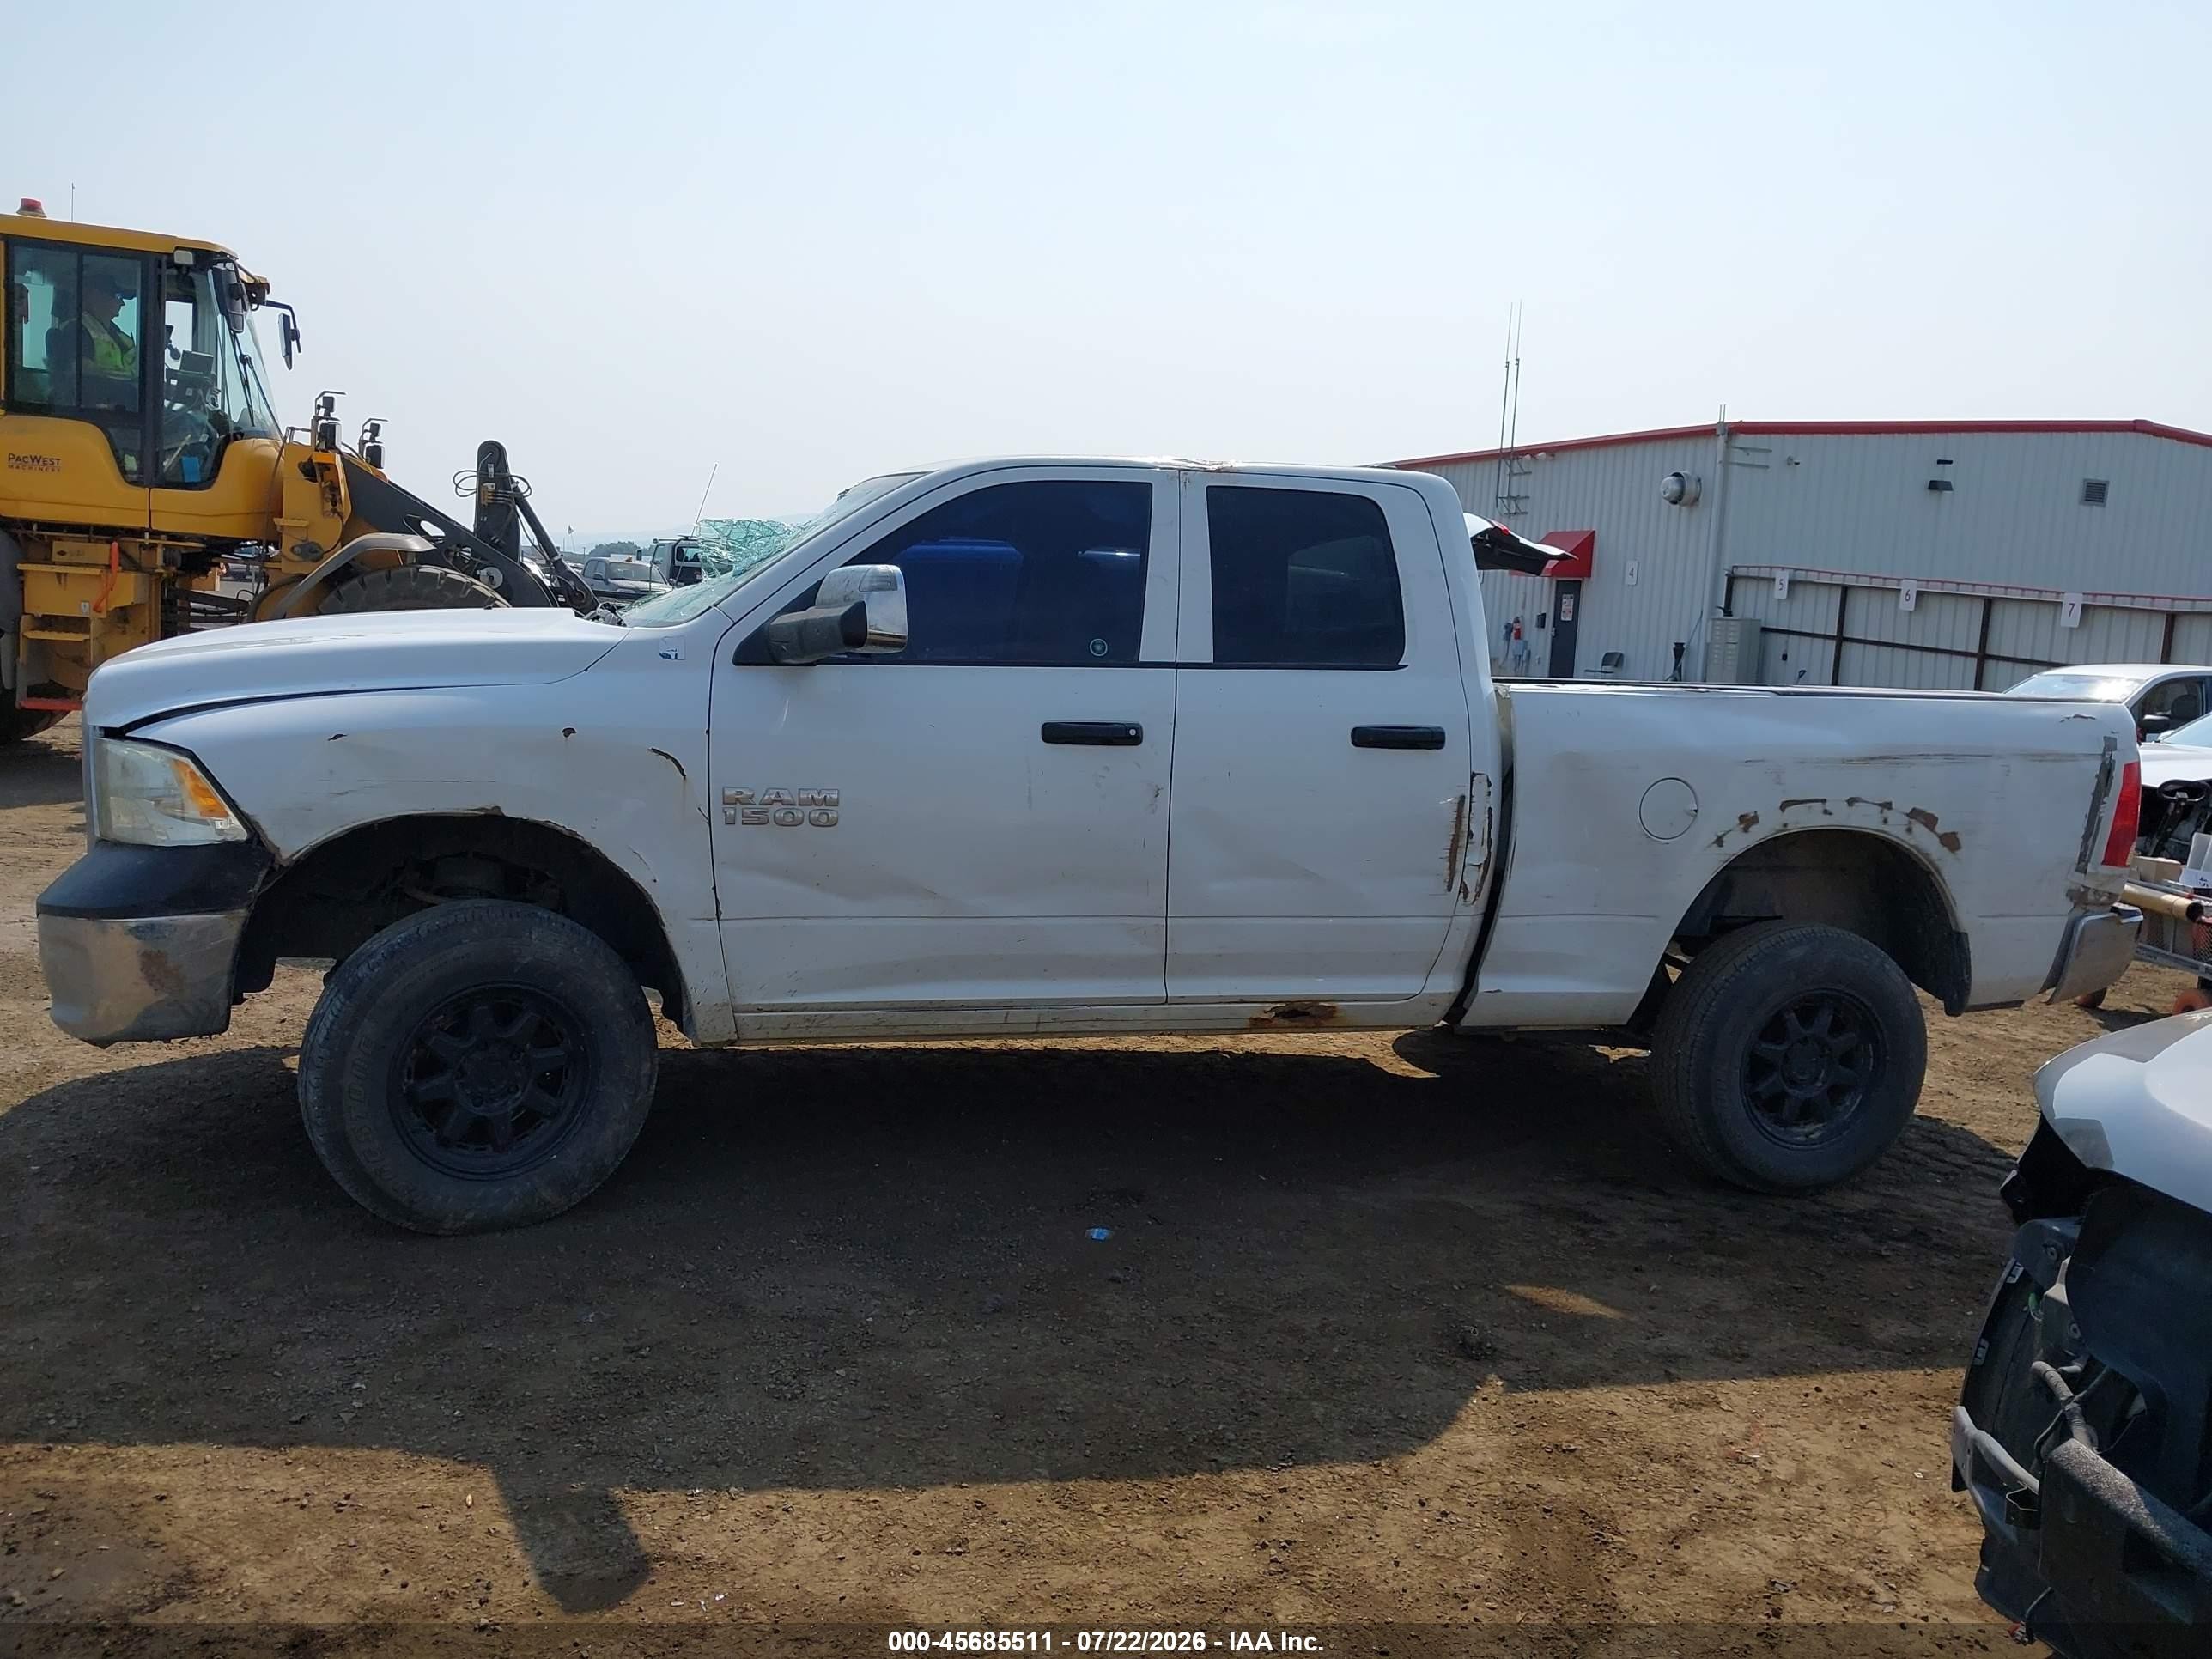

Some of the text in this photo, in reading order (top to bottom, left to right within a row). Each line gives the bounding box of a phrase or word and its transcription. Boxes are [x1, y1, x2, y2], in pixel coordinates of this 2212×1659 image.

[1778, 578, 1785, 591] 5
[1904, 589, 1911, 602] 6
[2068, 602, 2076, 618] 7
[722, 786, 840, 806] RAM
[722, 806, 839, 827] 1500
